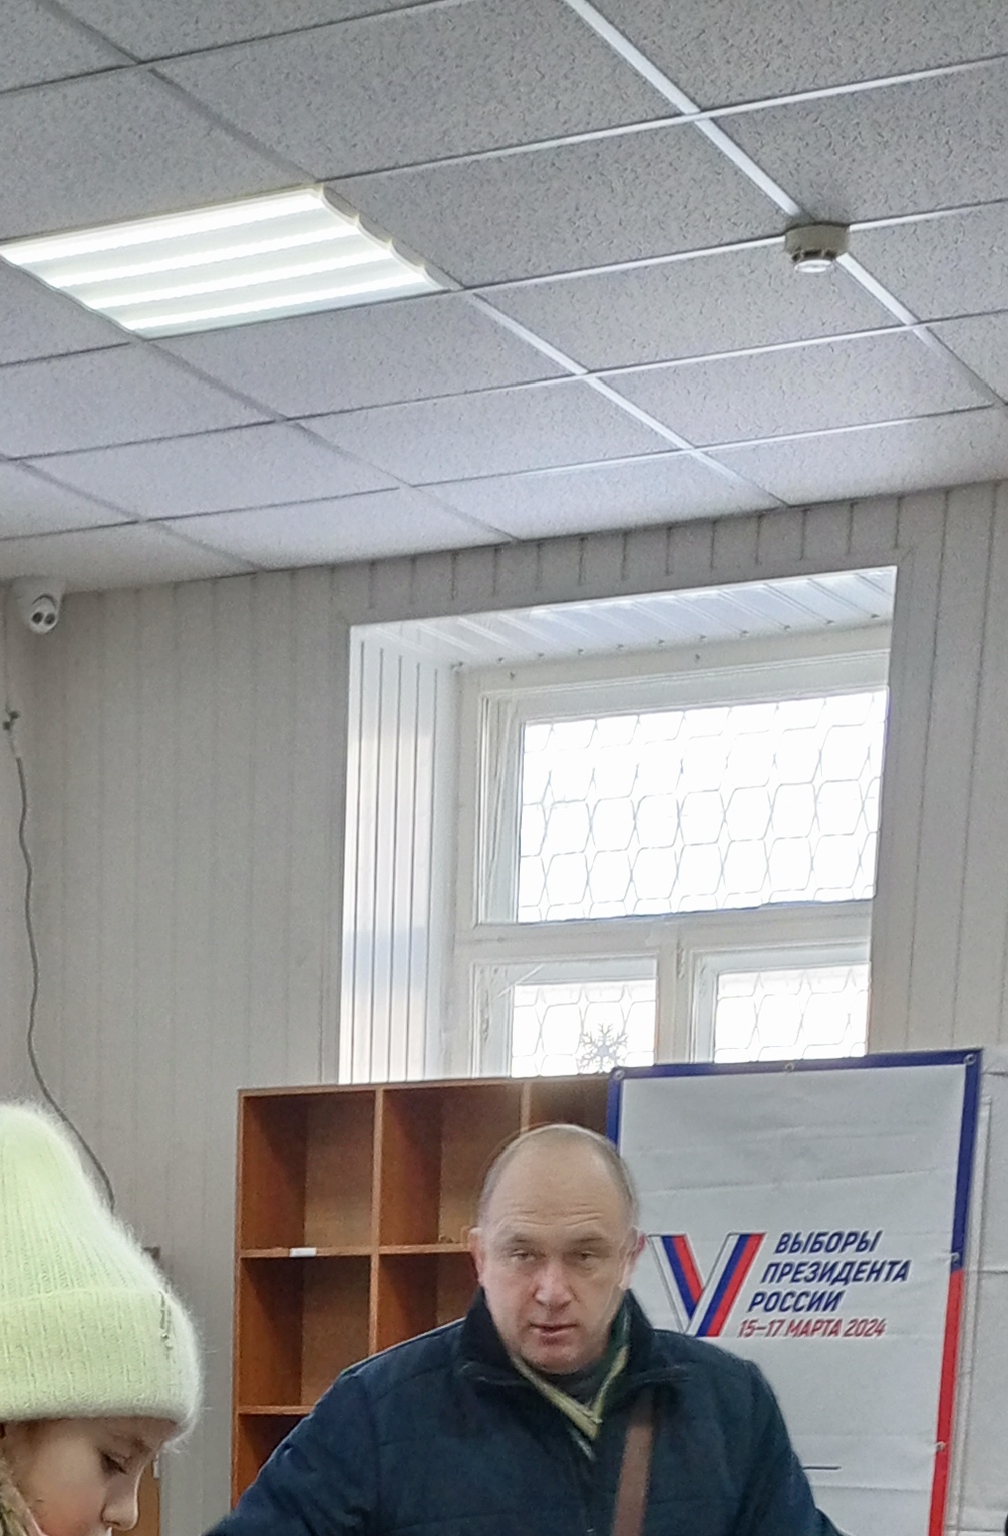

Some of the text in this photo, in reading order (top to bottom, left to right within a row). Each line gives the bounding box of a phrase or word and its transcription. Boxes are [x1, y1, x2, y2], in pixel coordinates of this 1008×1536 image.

[774, 1230, 882, 1255] ВЫБОРЫ
[760, 1260, 911, 1285] ПРЕЗИДЕНТА
[747, 1290, 845, 1313] РОССИИ
[789, 1319, 840, 1338] МАРТА
[844, 1318, 887, 1337] 2024
